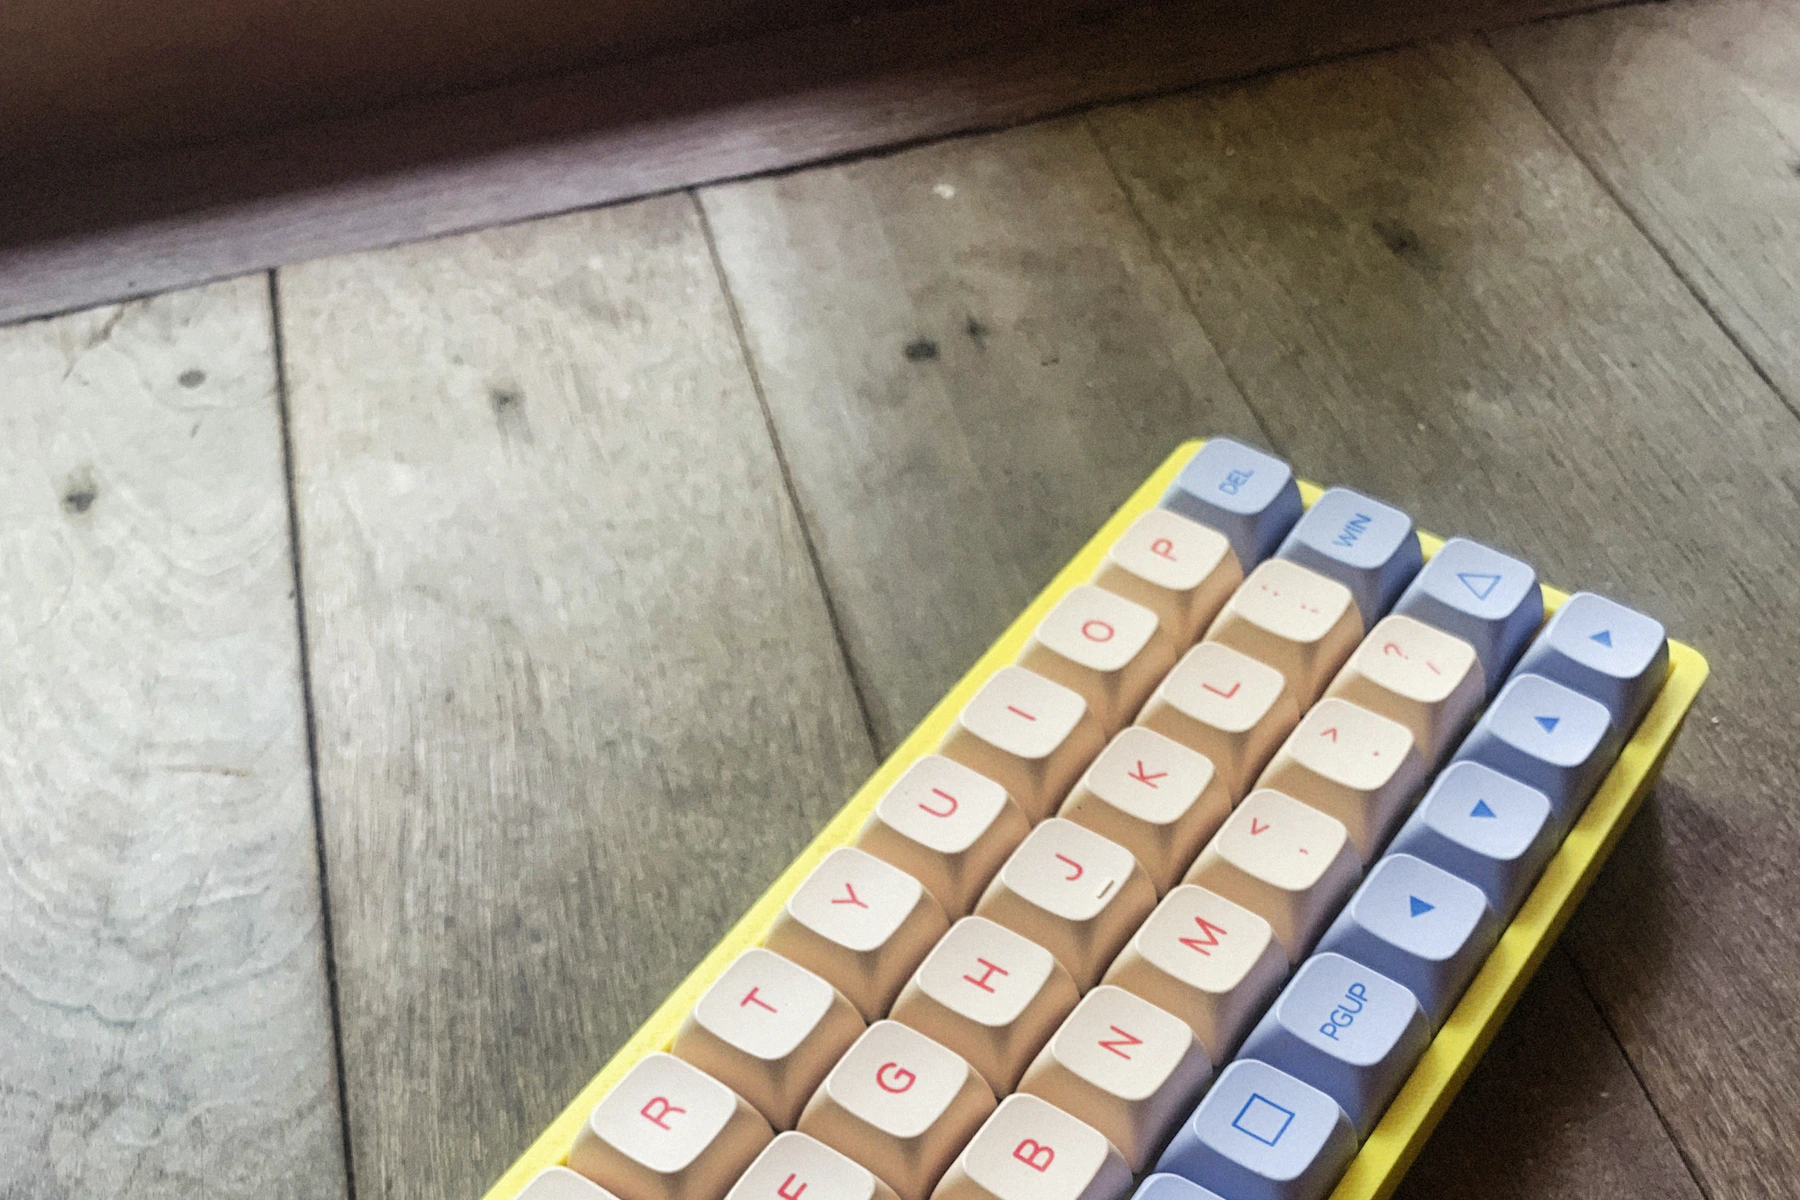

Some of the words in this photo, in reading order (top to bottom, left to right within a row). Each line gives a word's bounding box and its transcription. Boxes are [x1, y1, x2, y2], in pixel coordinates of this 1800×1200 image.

[1219, 470, 1254, 494] DEL
[1331, 513, 1372, 546] WIN
[1151, 539, 1175, 560] P
[1082, 621, 1114, 642] O
[1203, 683, 1240, 699] L
[1007, 706, 1035, 721] I
[1129, 761, 1166, 787] K
[919, 788, 958, 817] U
[1056, 854, 1083, 881] J
[832, 883, 867, 908] Y
[1180, 917, 1226, 955] M
[964, 958, 1008, 993] H
[741, 987, 776, 1012] T
[1320, 982, 1367, 1039] PGUP
[1099, 1026, 1142, 1059] N
[876, 1062, 916, 1094] G
[640, 1096, 685, 1130] R
[1013, 1139, 1054, 1172] B
